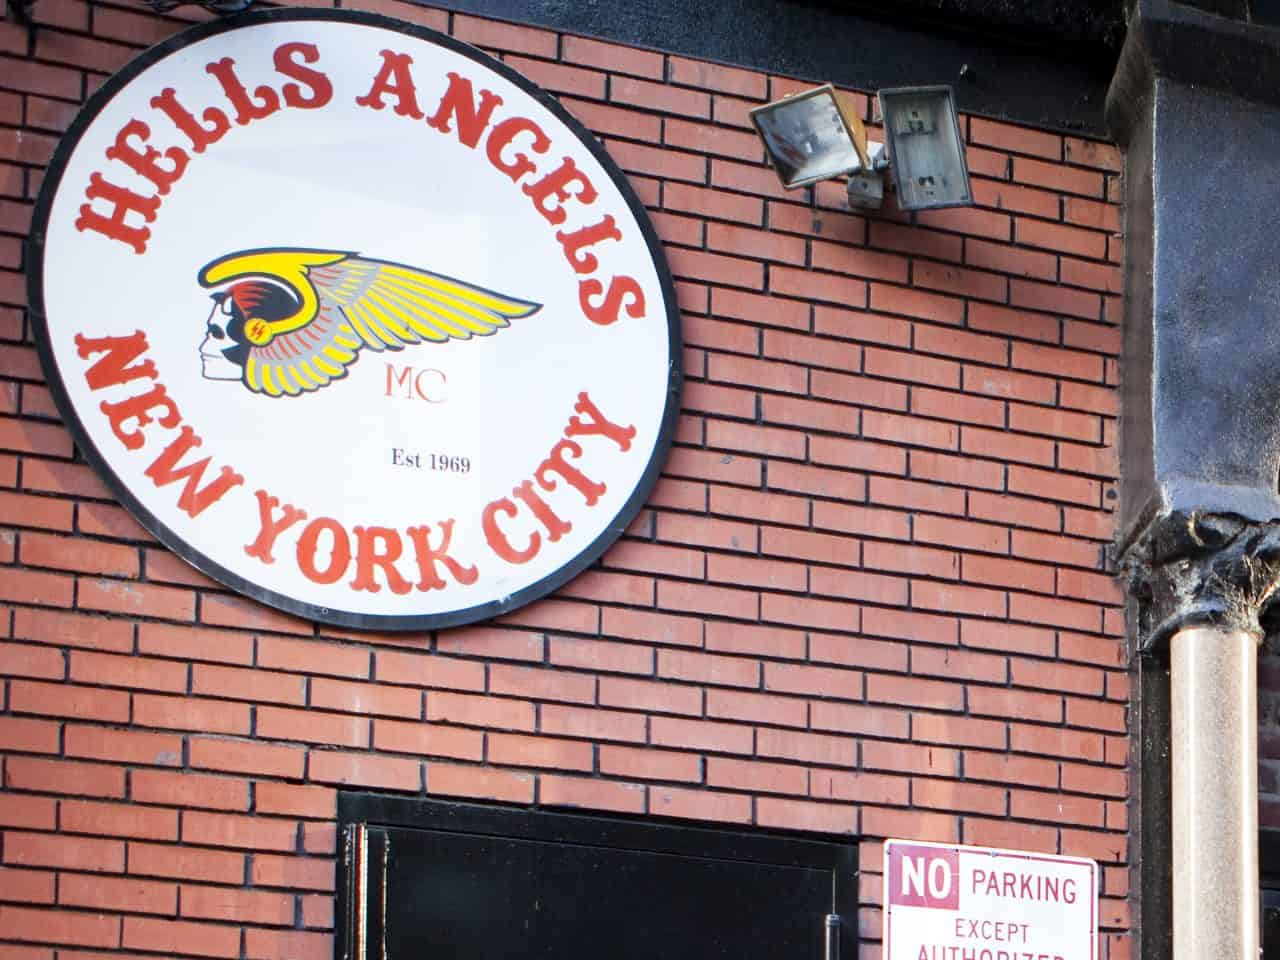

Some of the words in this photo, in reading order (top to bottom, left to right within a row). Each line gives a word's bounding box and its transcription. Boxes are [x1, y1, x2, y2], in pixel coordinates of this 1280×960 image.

[75, 41, 333, 255] HELLS
[356, 49, 646, 327] ANGELS
[384, 362, 448, 404] MC
[74, 329, 244, 519] NEW
[243, 489, 480, 595] YORK
[481, 391, 637, 564] CITY
[392, 448, 422, 469] Est
[430, 453, 471, 473] 1969
[901, 855, 951, 899] NO
[971, 869, 1077, 905] PARKING
[955, 918, 1030, 944] EXCEPT
